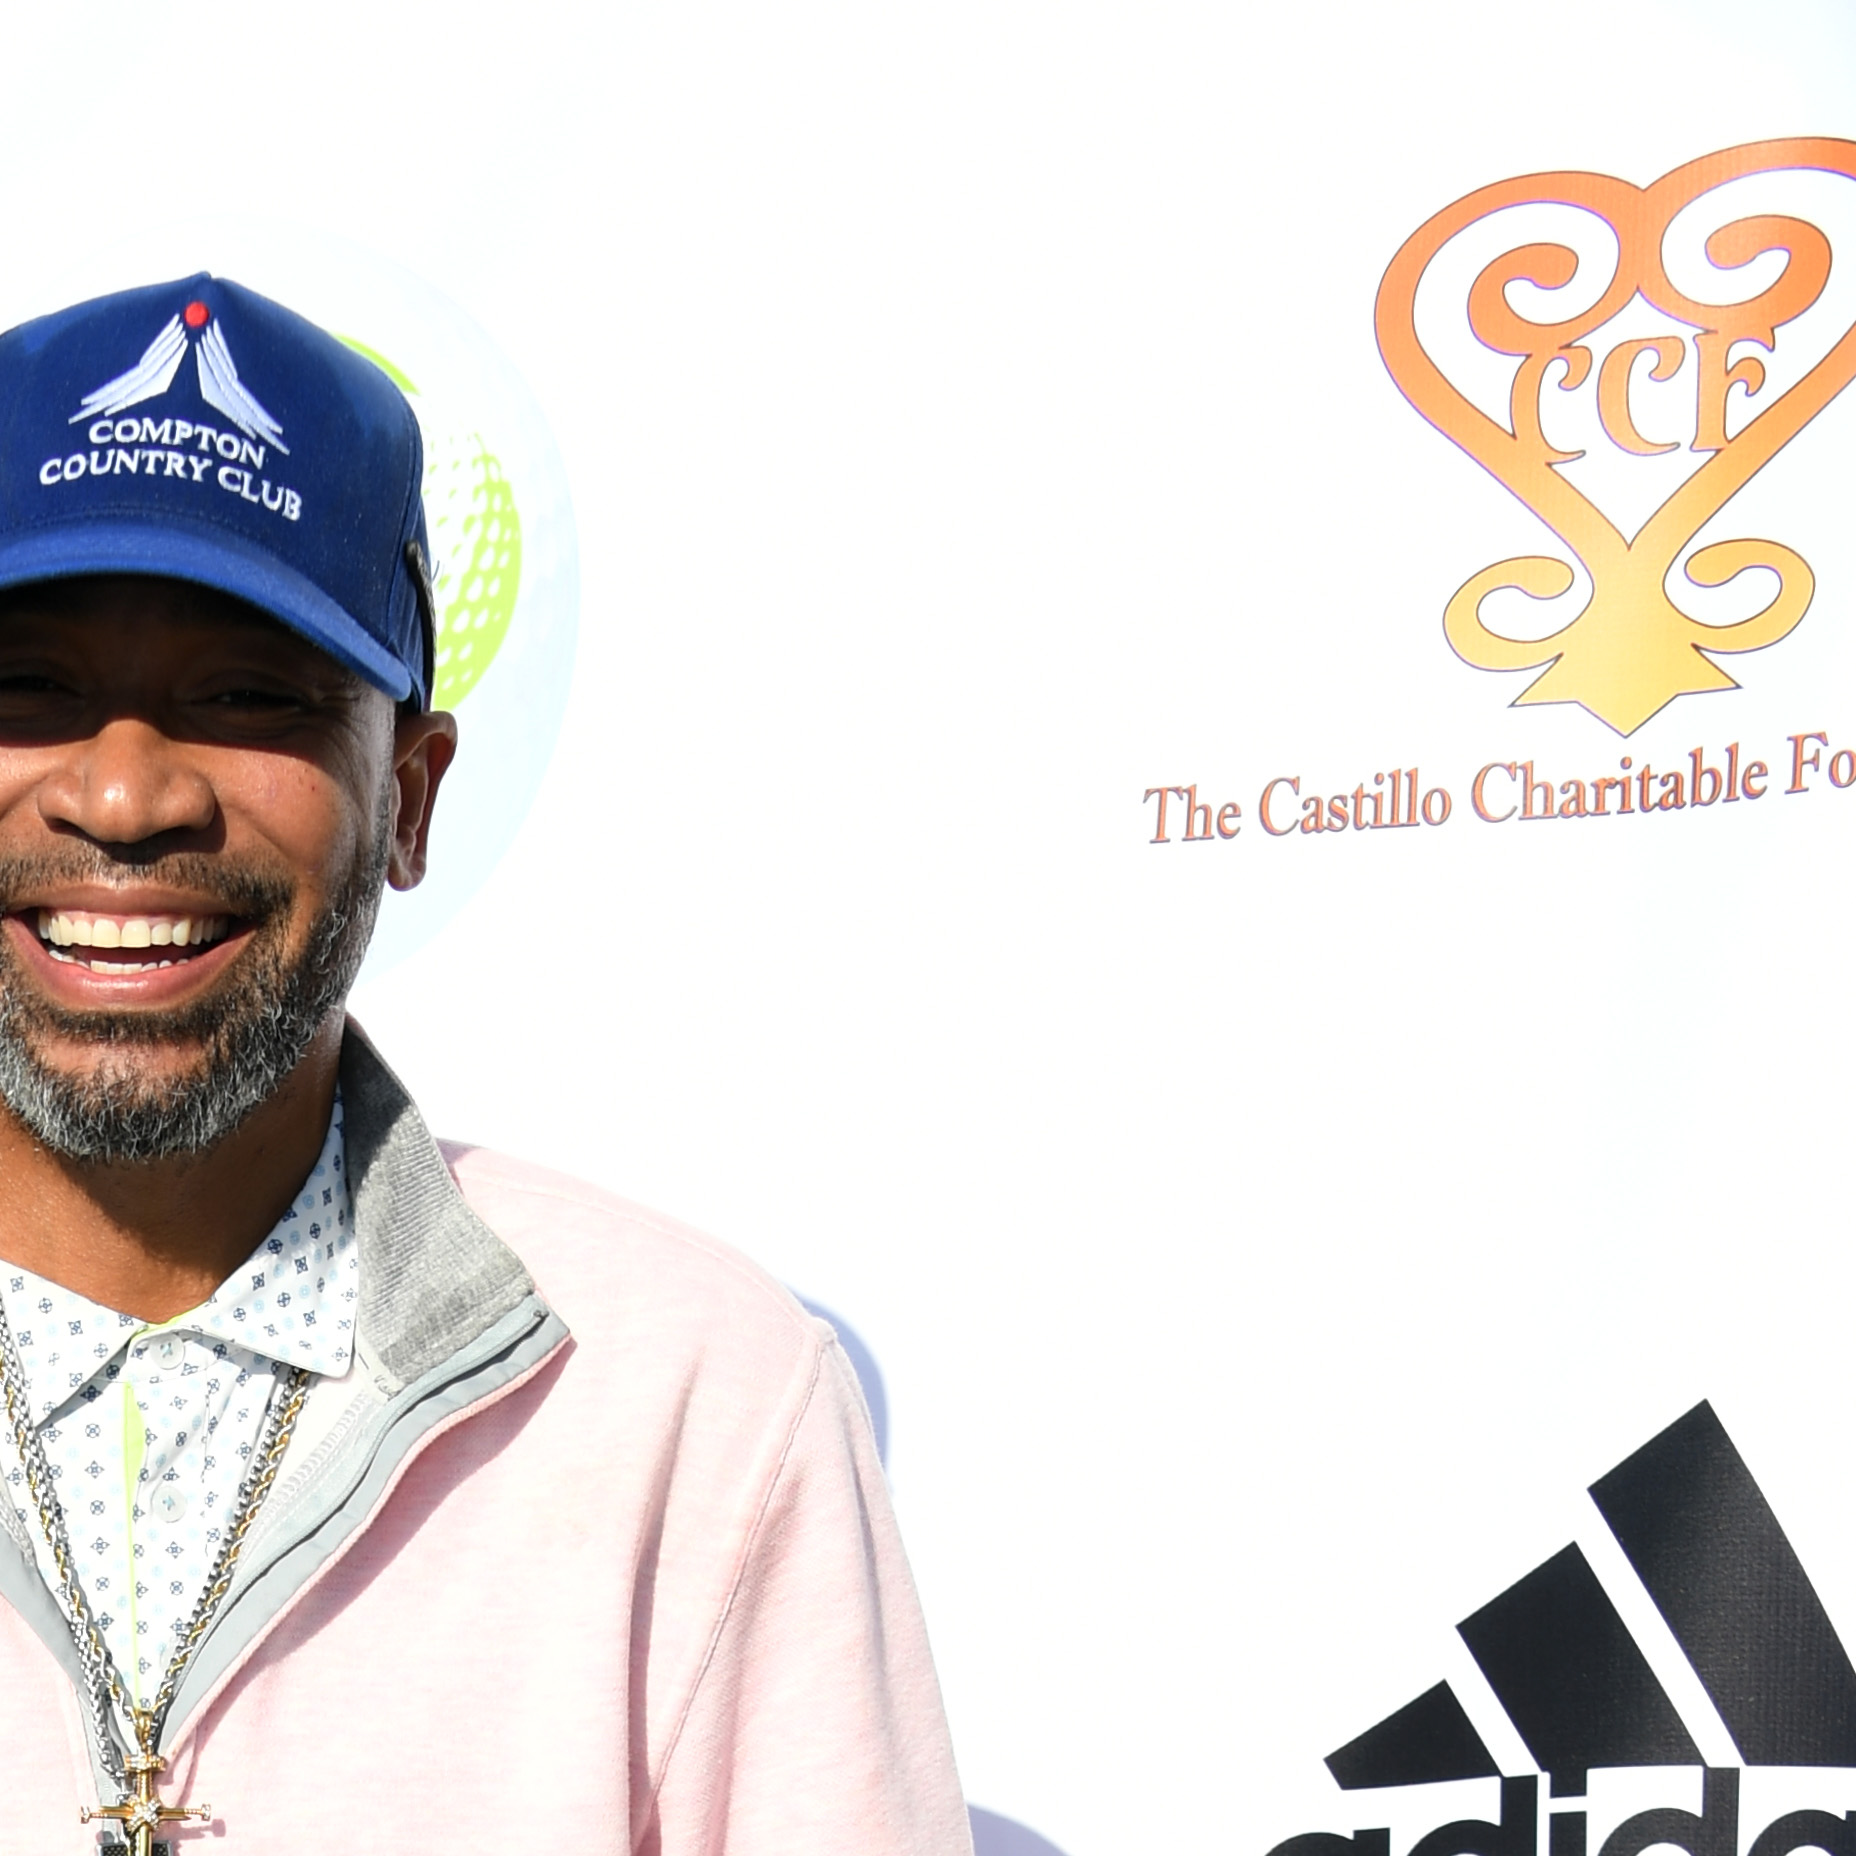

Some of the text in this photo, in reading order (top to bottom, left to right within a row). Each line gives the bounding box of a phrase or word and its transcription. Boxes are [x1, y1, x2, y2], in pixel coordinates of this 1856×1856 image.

[88, 417, 266, 470] COMPTON
[39, 448, 303, 521] COUNTRY CLUB
[1144, 784, 1242, 843] The
[1259, 767, 1453, 837] Castillo
[1471, 742, 1769, 823] Charitable
